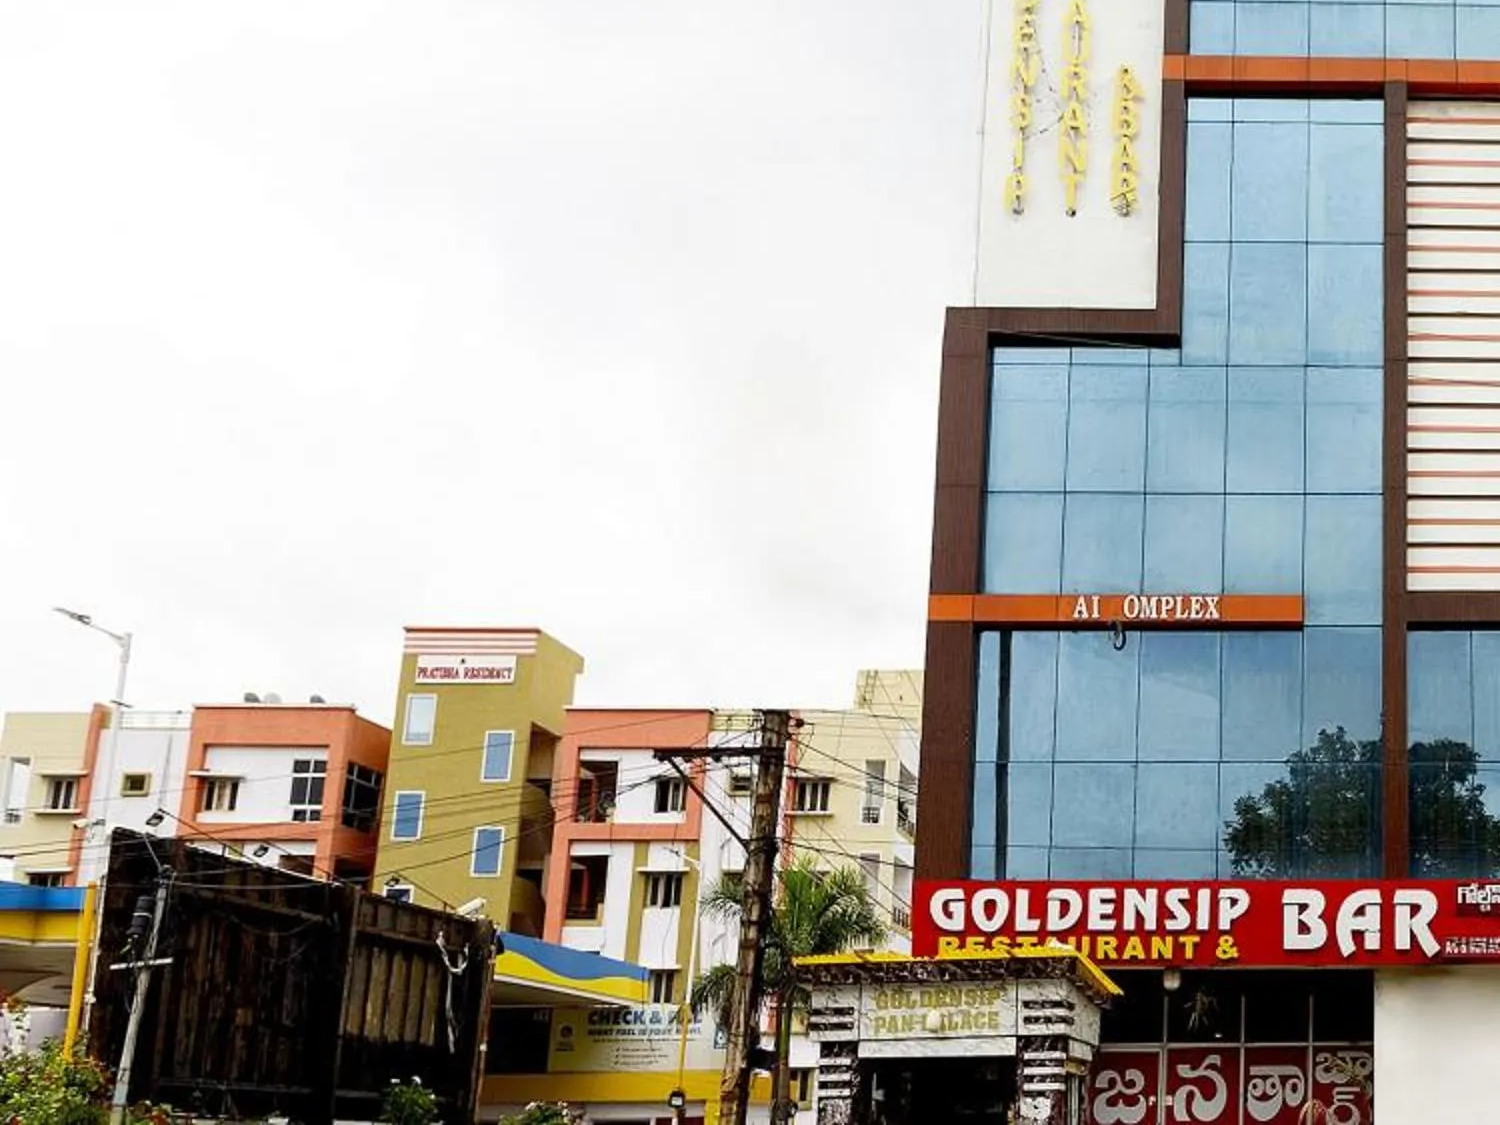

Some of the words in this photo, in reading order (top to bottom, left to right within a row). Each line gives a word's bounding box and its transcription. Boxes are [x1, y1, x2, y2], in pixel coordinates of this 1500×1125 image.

[929, 887, 1250, 933] GOLDENSIP
[1281, 888, 1441, 959] BAR
[1215, 936, 1239, 959] &
[587, 1010, 645, 1025] CHECK
